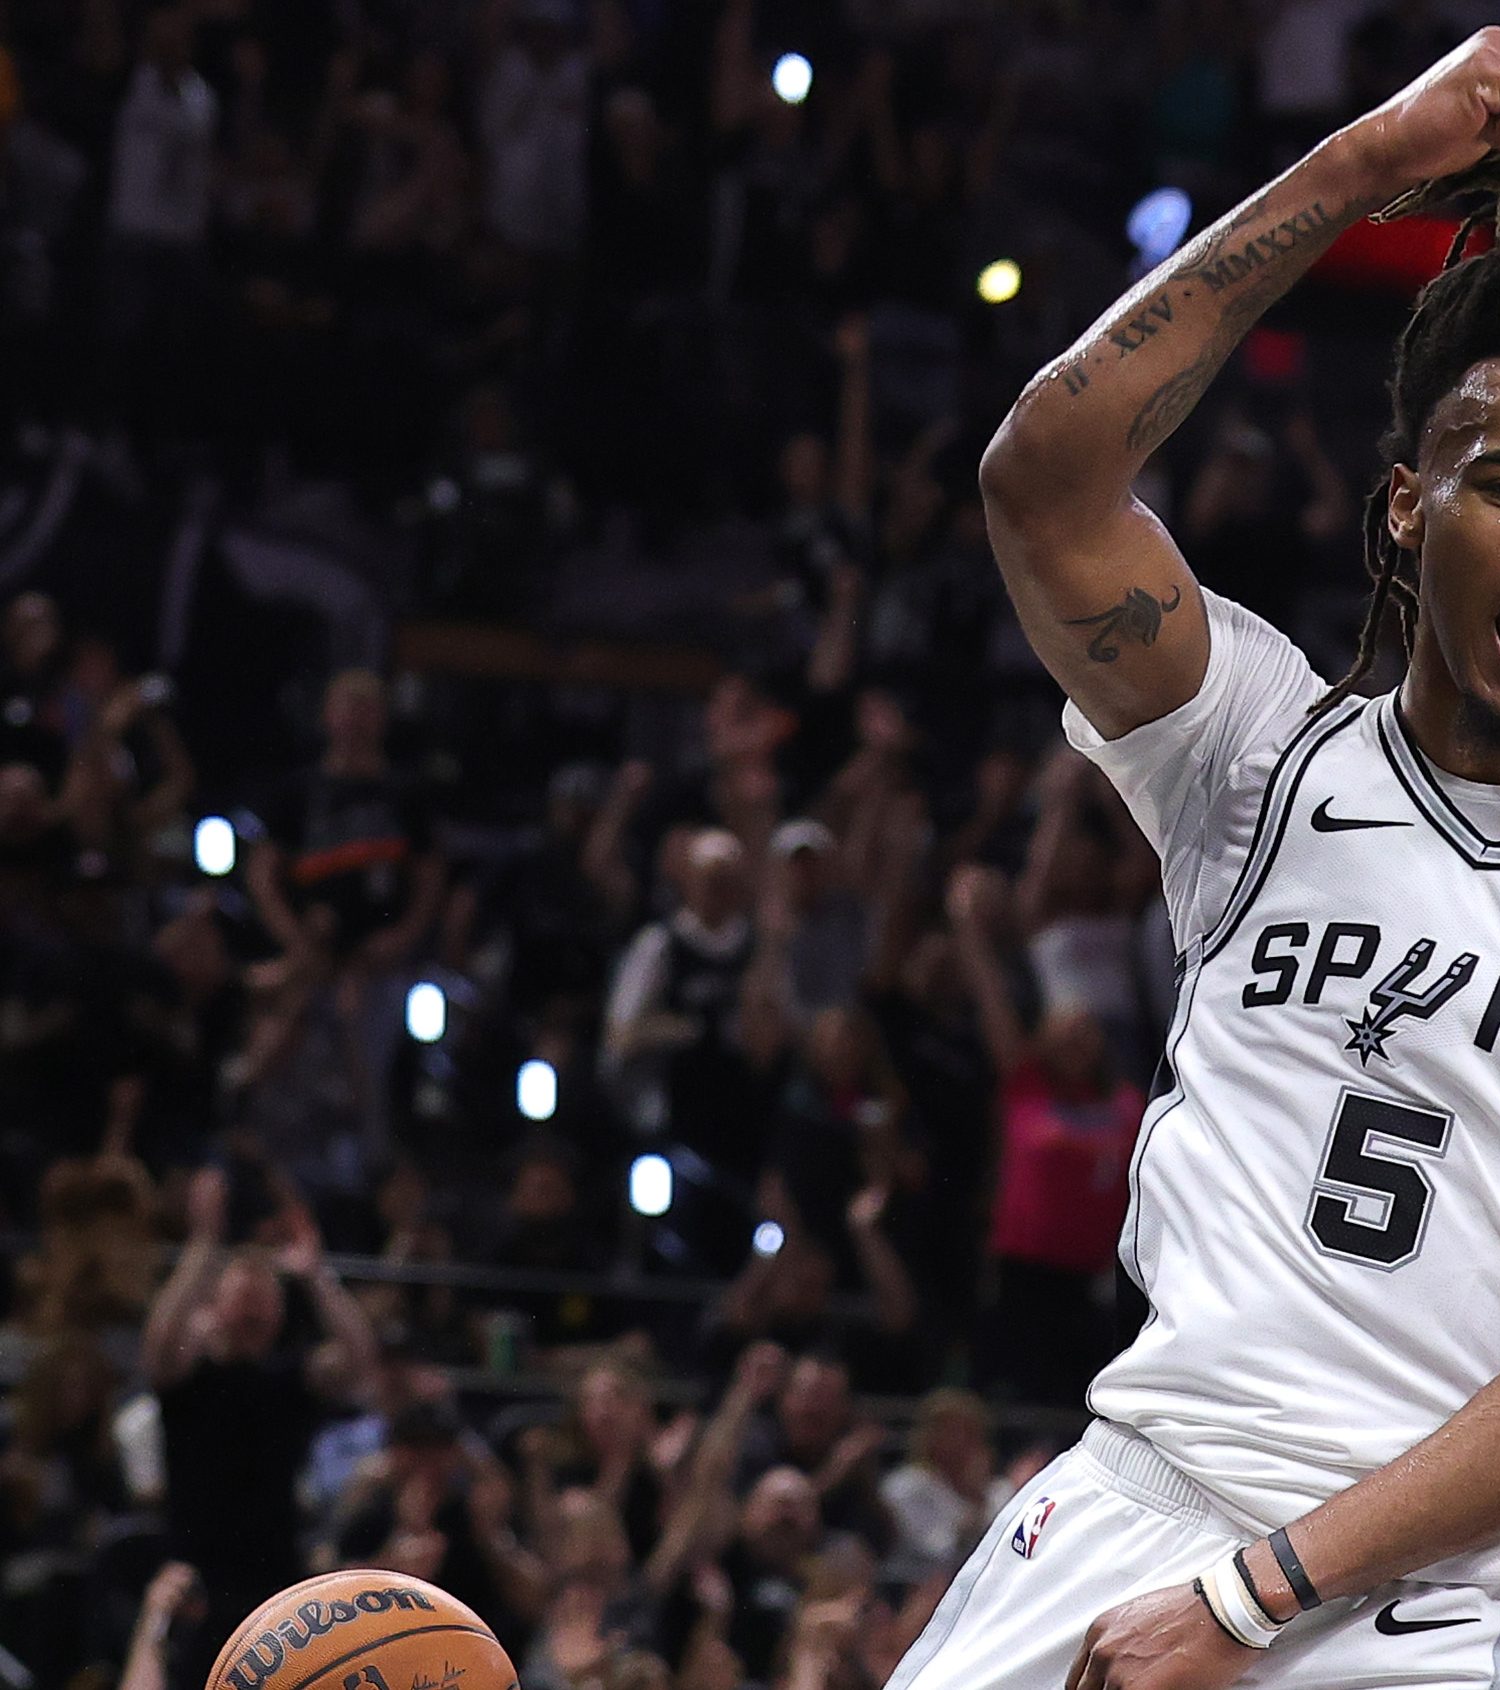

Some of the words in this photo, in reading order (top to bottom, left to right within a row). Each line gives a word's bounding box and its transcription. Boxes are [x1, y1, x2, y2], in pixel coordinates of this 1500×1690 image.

[1111, 294, 1174, 358] XXV
[1200, 203, 1332, 291] MMXXII
[1303, 1085, 1455, 1273] 5
[227, 1587, 436, 1690] Wilson
